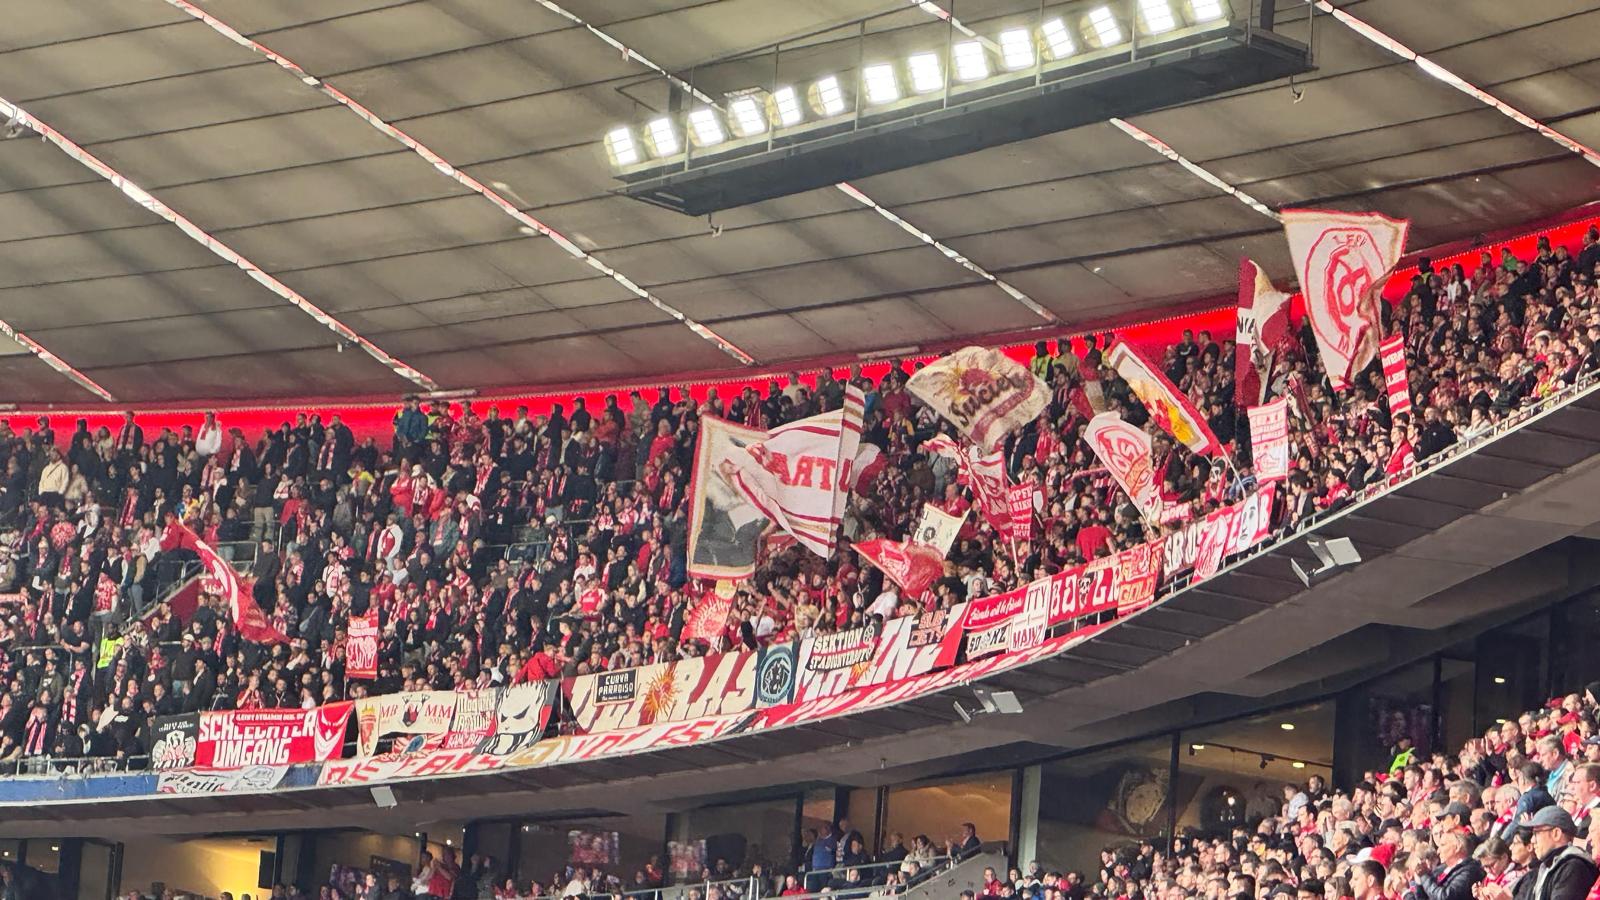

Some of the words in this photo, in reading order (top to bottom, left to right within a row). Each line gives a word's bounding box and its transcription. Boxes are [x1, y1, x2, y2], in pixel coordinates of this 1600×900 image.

[813, 627, 863, 654] SEKTION
[605, 673, 629, 685] CURVA
[598, 683, 634, 696] PARADISO
[424, 703, 451, 719] MM
[212, 737, 293, 768] UMGANG
